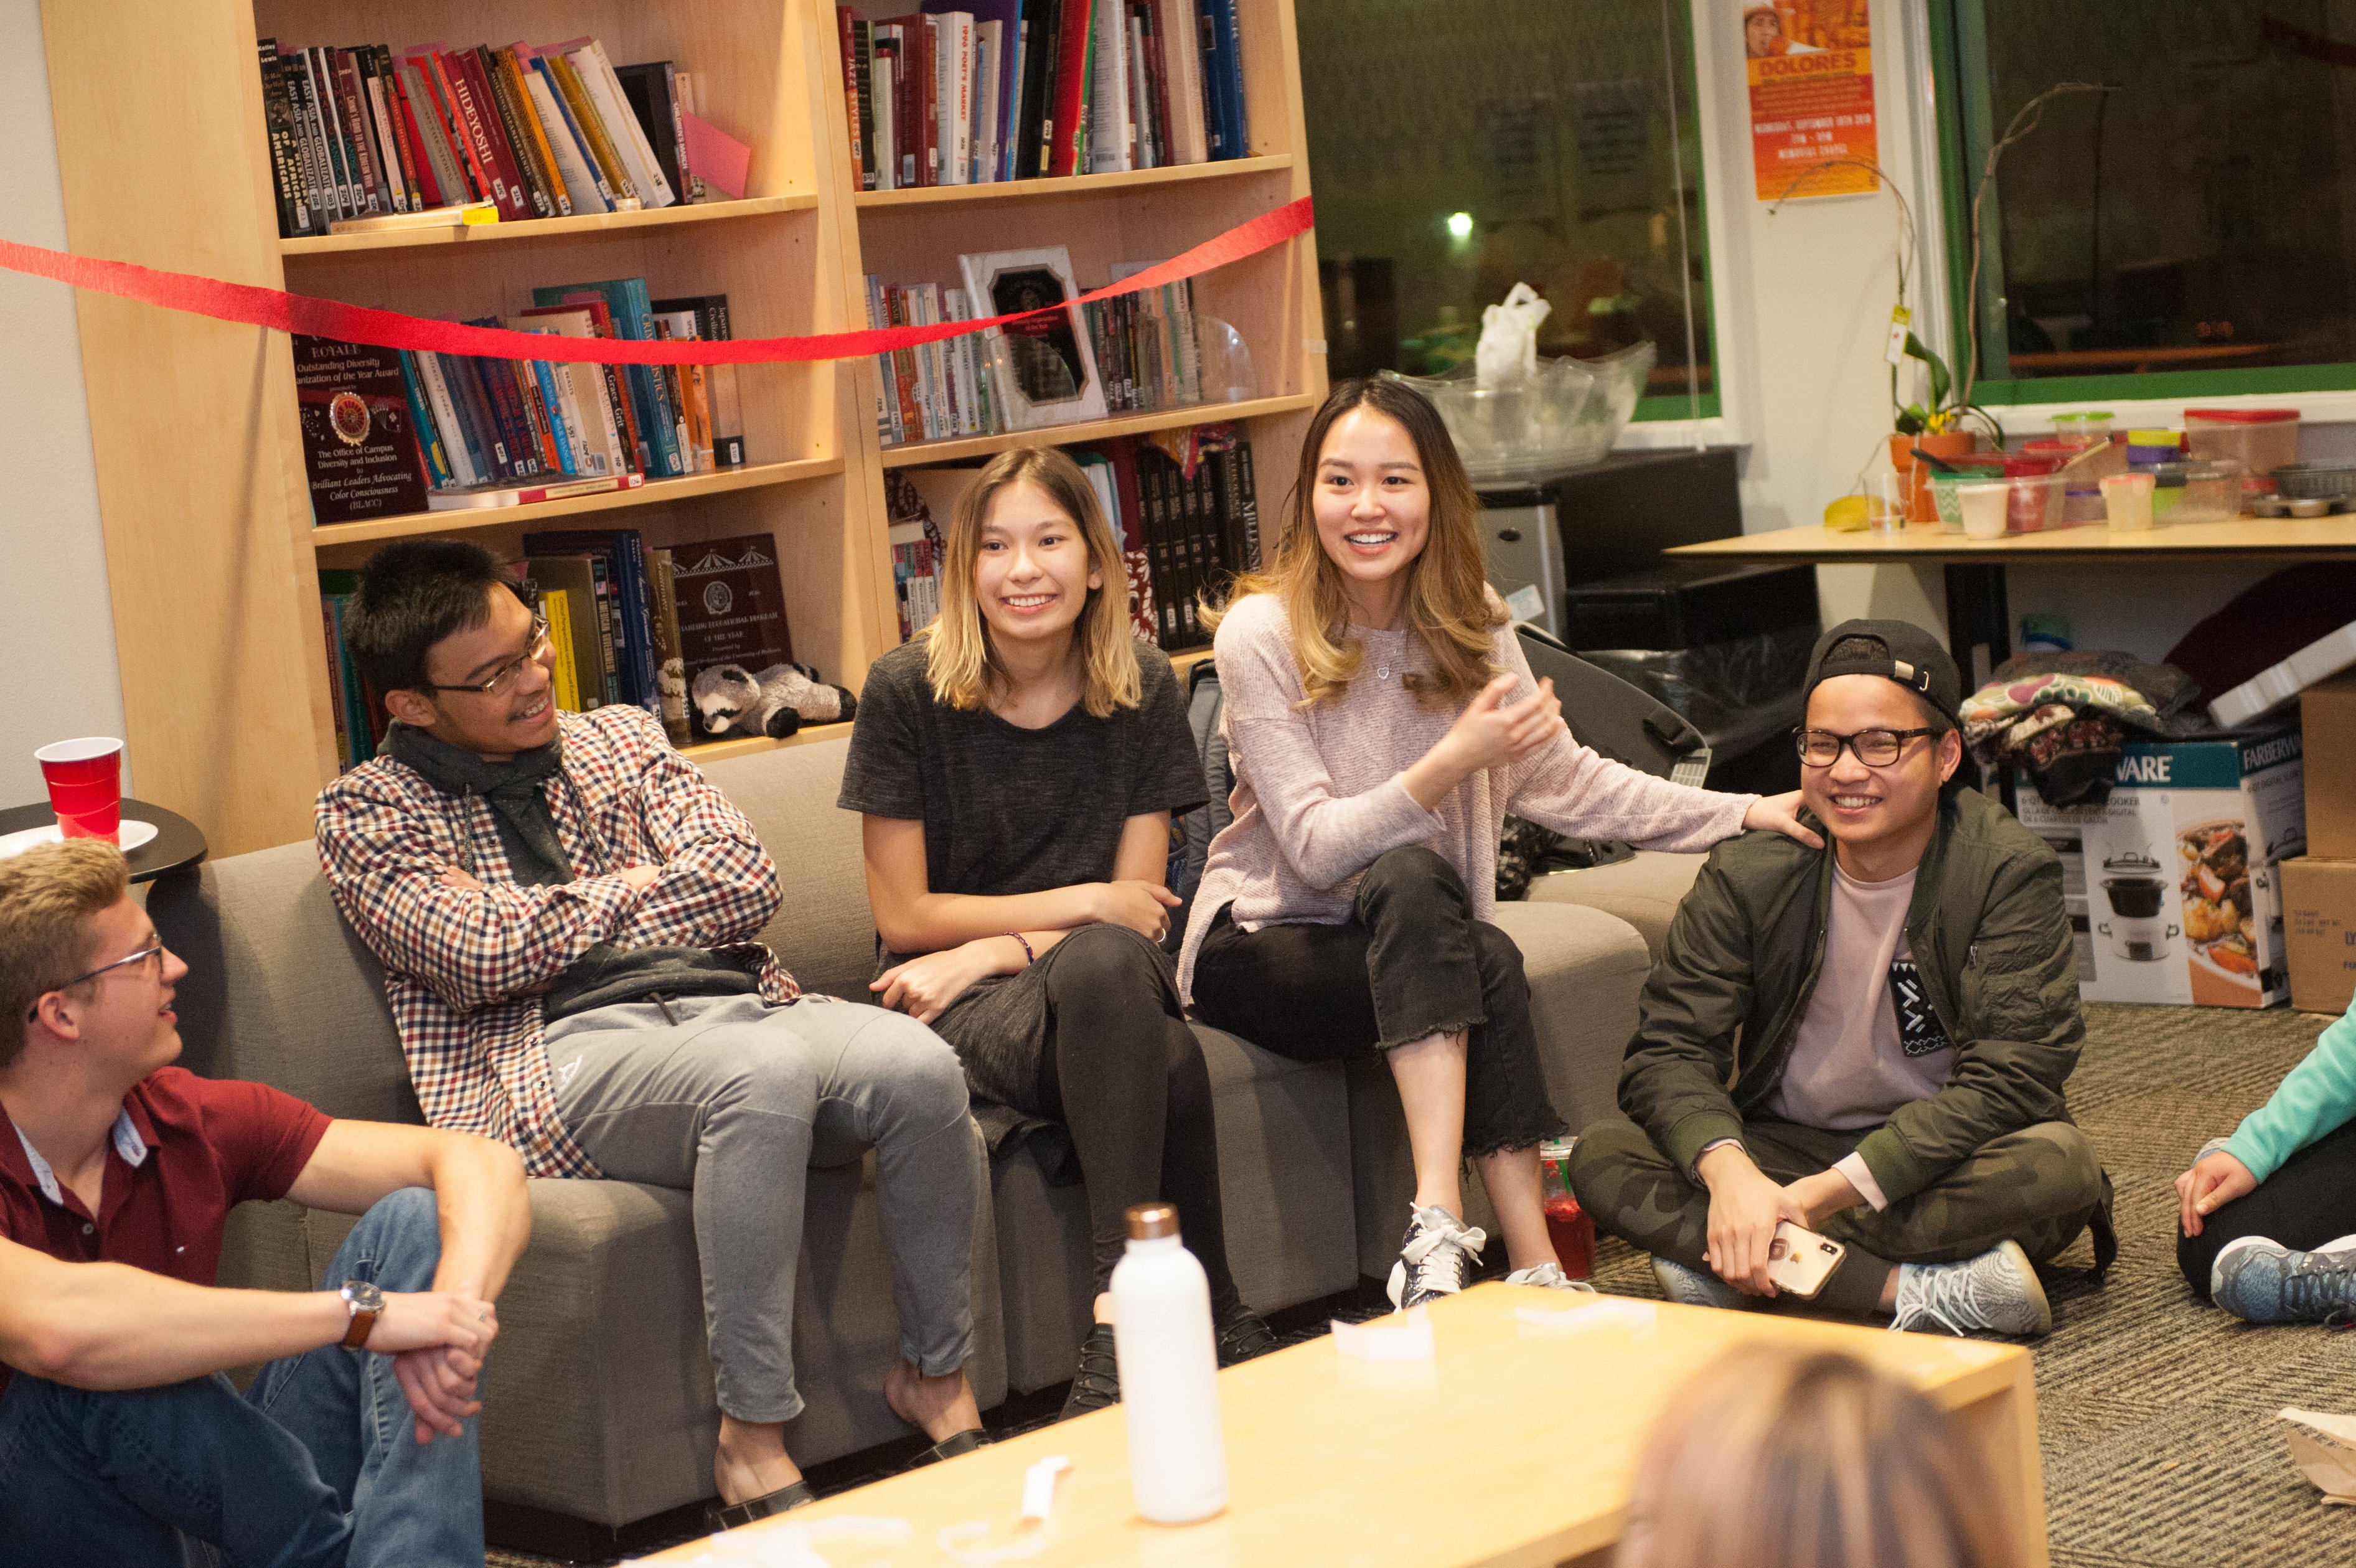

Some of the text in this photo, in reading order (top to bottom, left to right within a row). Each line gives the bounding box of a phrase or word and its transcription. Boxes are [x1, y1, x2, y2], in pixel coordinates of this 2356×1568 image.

[848, 57, 857, 86] JAZZ
[1759, 52, 1856, 75] DOLORES
[288, 81, 298, 101] EAST
[302, 80, 312, 102] EAST
[292, 103, 303, 122] ASIA
[306, 103, 316, 121] ASIA
[456, 78, 493, 164] HIDEYOSHI
[850, 92, 860, 139] STYLES
[272, 133, 291, 199] AMERICANS
[299, 138, 316, 188] GLOBALIZATI
[314, 137, 331, 187] GLOBALIZATI
[287, 158, 303, 207] AFRICAN
[710, 307, 719, 341] Civilizat
[718, 307, 728, 340] Japanes
[312, 344, 360, 358] ROYALE
[297, 359, 380, 372] Outstanding Diversity
[297, 368, 398, 384] anization of the Year Award
[562, 371, 576, 395] BEASTS
[606, 374, 620, 401] Grace
[614, 407, 626, 428] Grit
[318, 444, 393, 459] The Office of Campus
[318, 454, 397, 469] Diversity and Inclusion
[312, 472, 411, 489] Brilliant Leaders Advocating
[330, 486, 398, 500] Color Consciousness
[2243, 736, 2301, 770] FARBERW
[2116, 756, 2173, 782] WARE
[2110, 797, 2139, 805] OOKER
